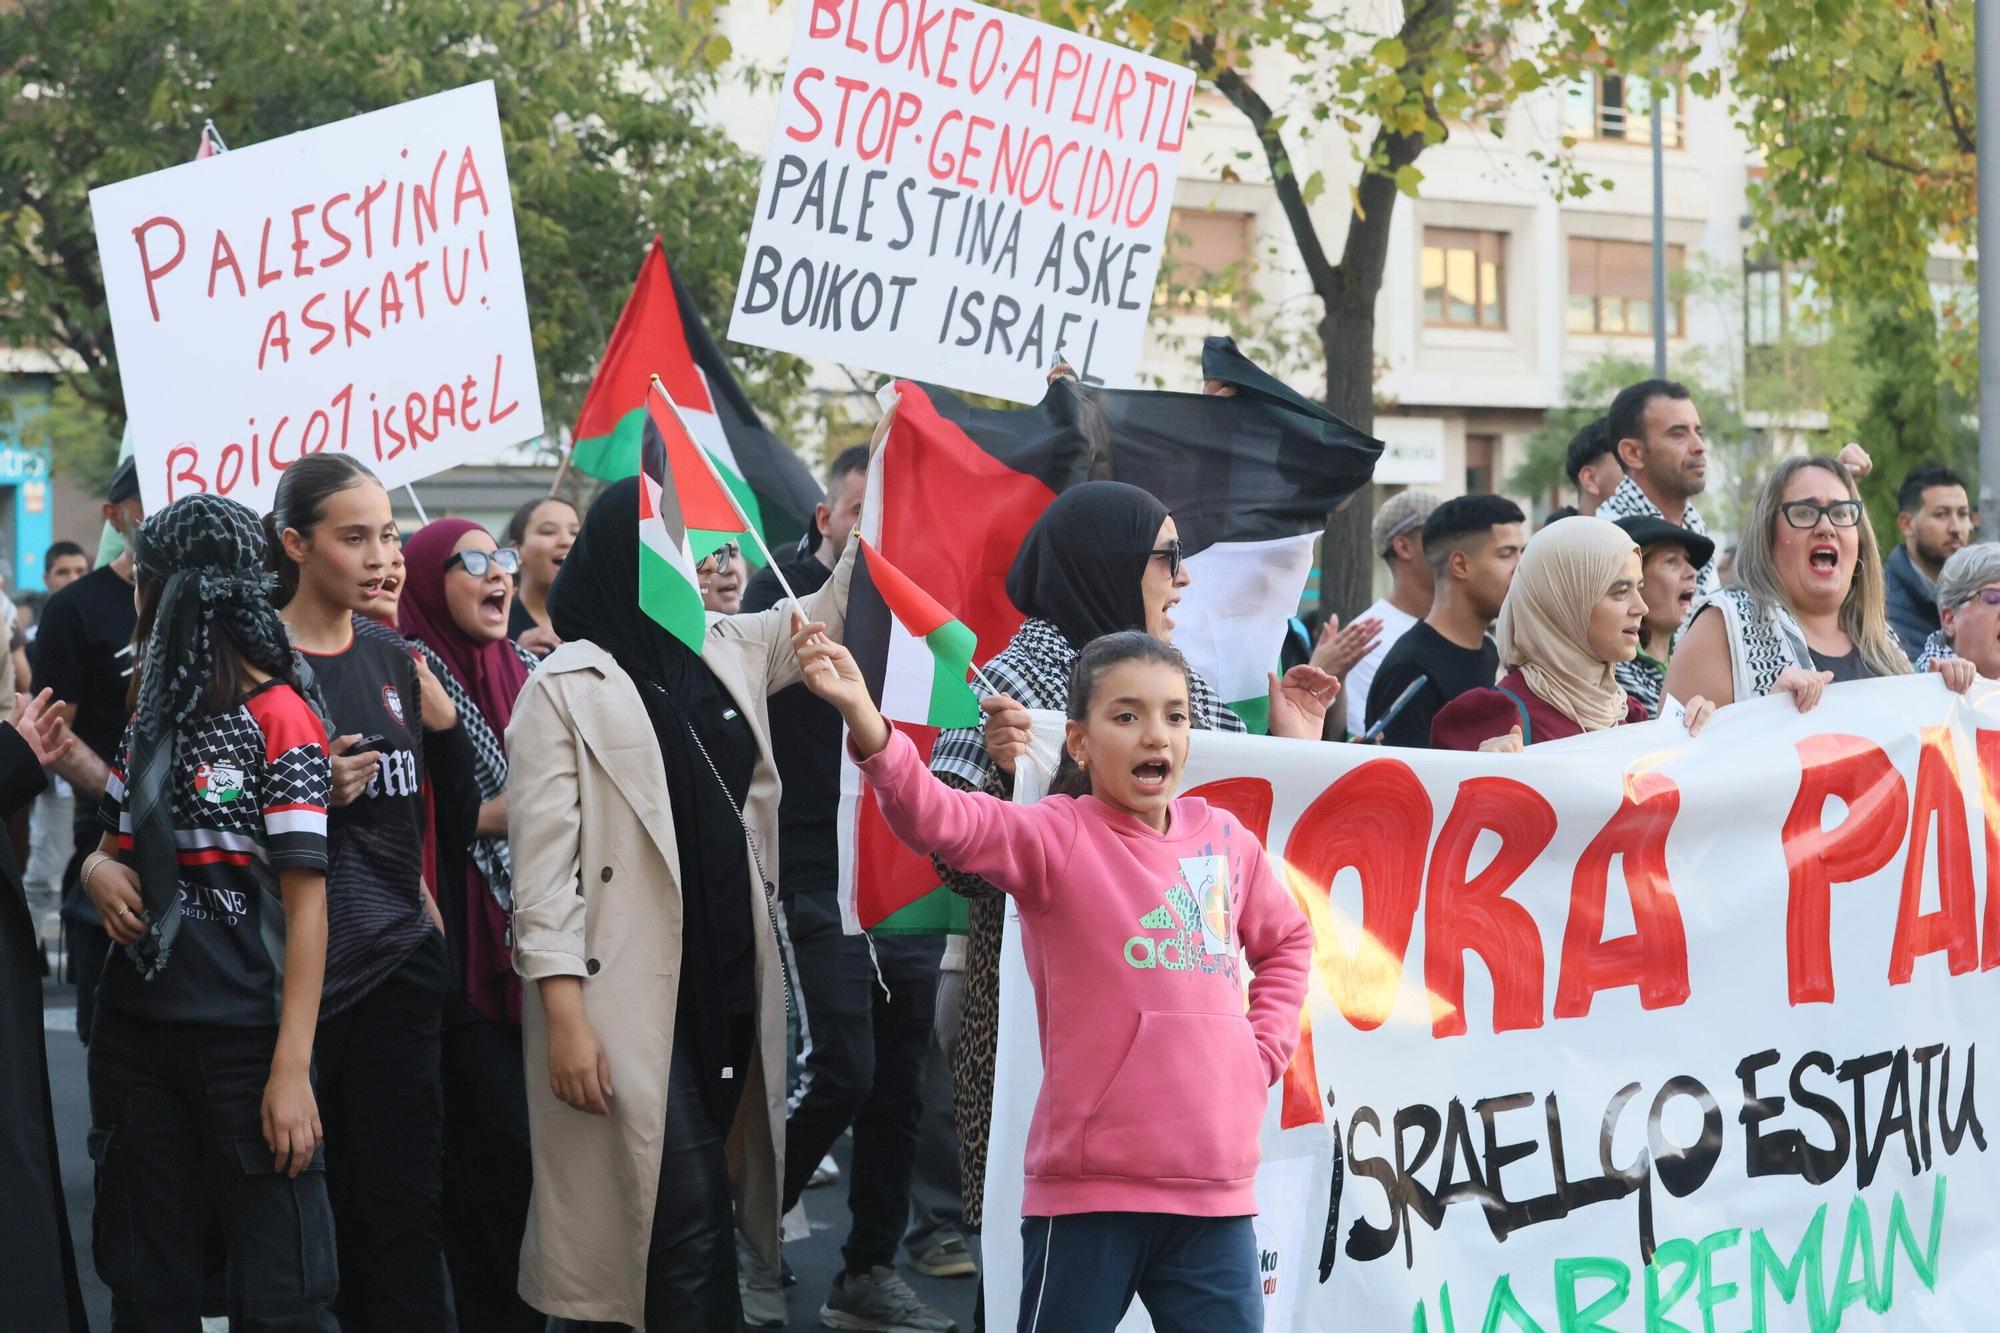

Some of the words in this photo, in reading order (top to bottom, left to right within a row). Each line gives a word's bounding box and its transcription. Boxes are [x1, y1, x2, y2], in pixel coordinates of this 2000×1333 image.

[258, 230, 490, 370] ASKATU!
[767, 154, 1023, 279] PALESTINA
[1034, 222, 1151, 310] ASKE
[741, 245, 917, 332] BOIKOT
[938, 285, 1105, 386] ISRAEL
[1736, 1042, 1987, 1190] ESTATU
